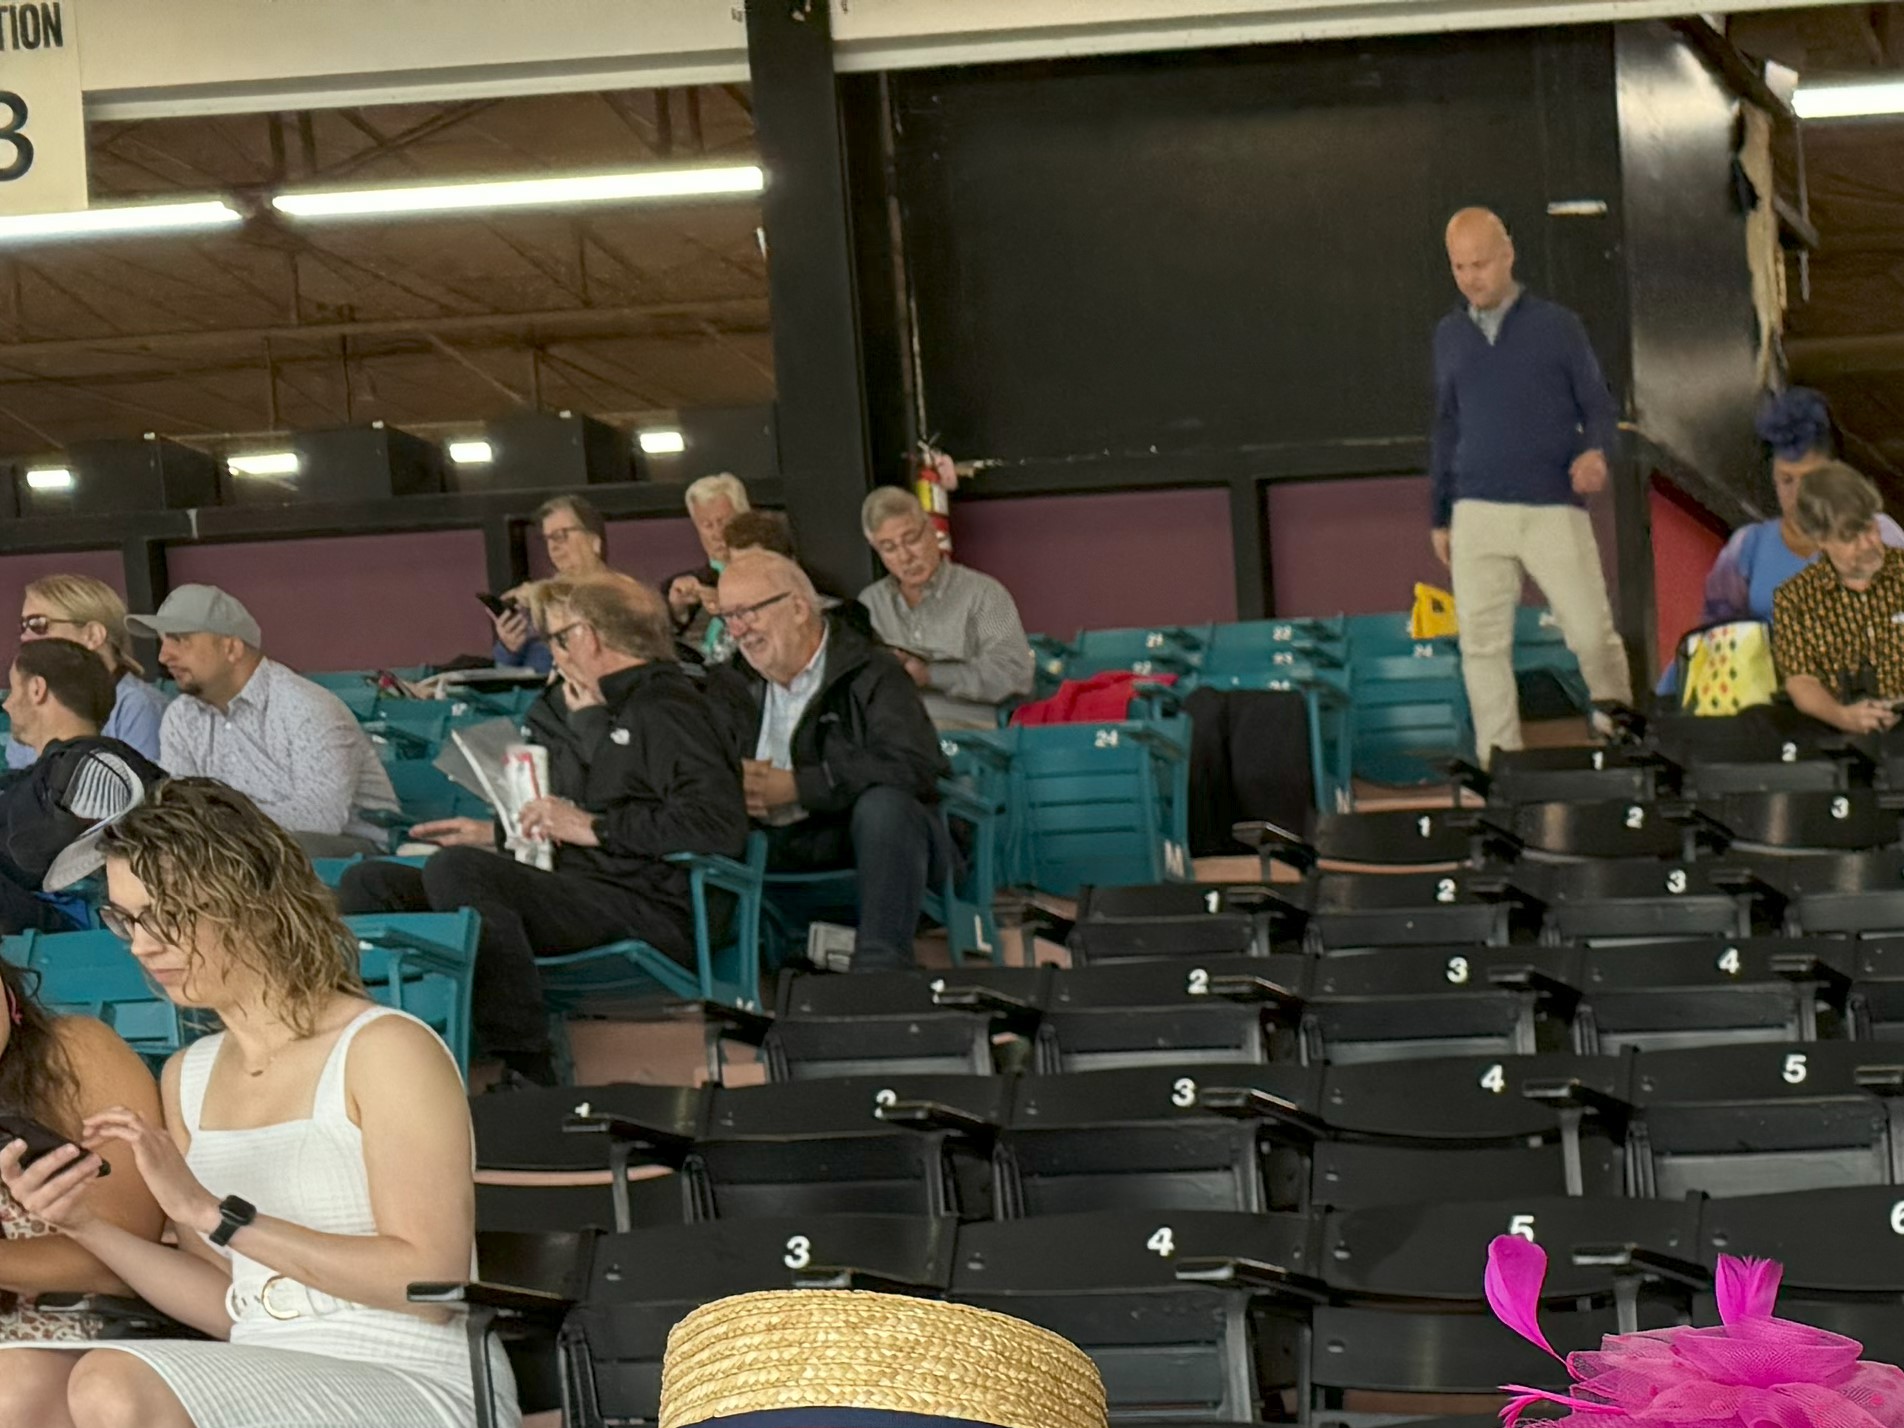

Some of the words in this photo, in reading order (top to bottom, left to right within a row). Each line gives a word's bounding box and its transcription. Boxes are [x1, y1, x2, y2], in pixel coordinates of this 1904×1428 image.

[1094, 729, 1119, 748] 24
[1593, 751, 1603, 770] 1
[1782, 742, 1797, 762] 2
[1626, 806, 1644, 828] 2
[1831, 797, 1849, 819] 3
[1418, 816, 1431, 837] 1
[1437, 878, 1456, 902] 2
[1667, 869, 1687, 894] 3
[1205, 890, 1219, 913] 1
[974, 915, 993, 952] L
[1446, 956, 1468, 983] 3
[1718, 948, 1740, 974] 4
[1188, 968, 1209, 994] 2
[1480, 1064, 1505, 1093] 4
[1782, 1054, 1807, 1084] 5
[1171, 1077, 1195, 1107] 3
[1146, 1226, 1175, 1257] 4
[1509, 1214, 1535, 1243] 5
[783, 1235, 811, 1269] 3
